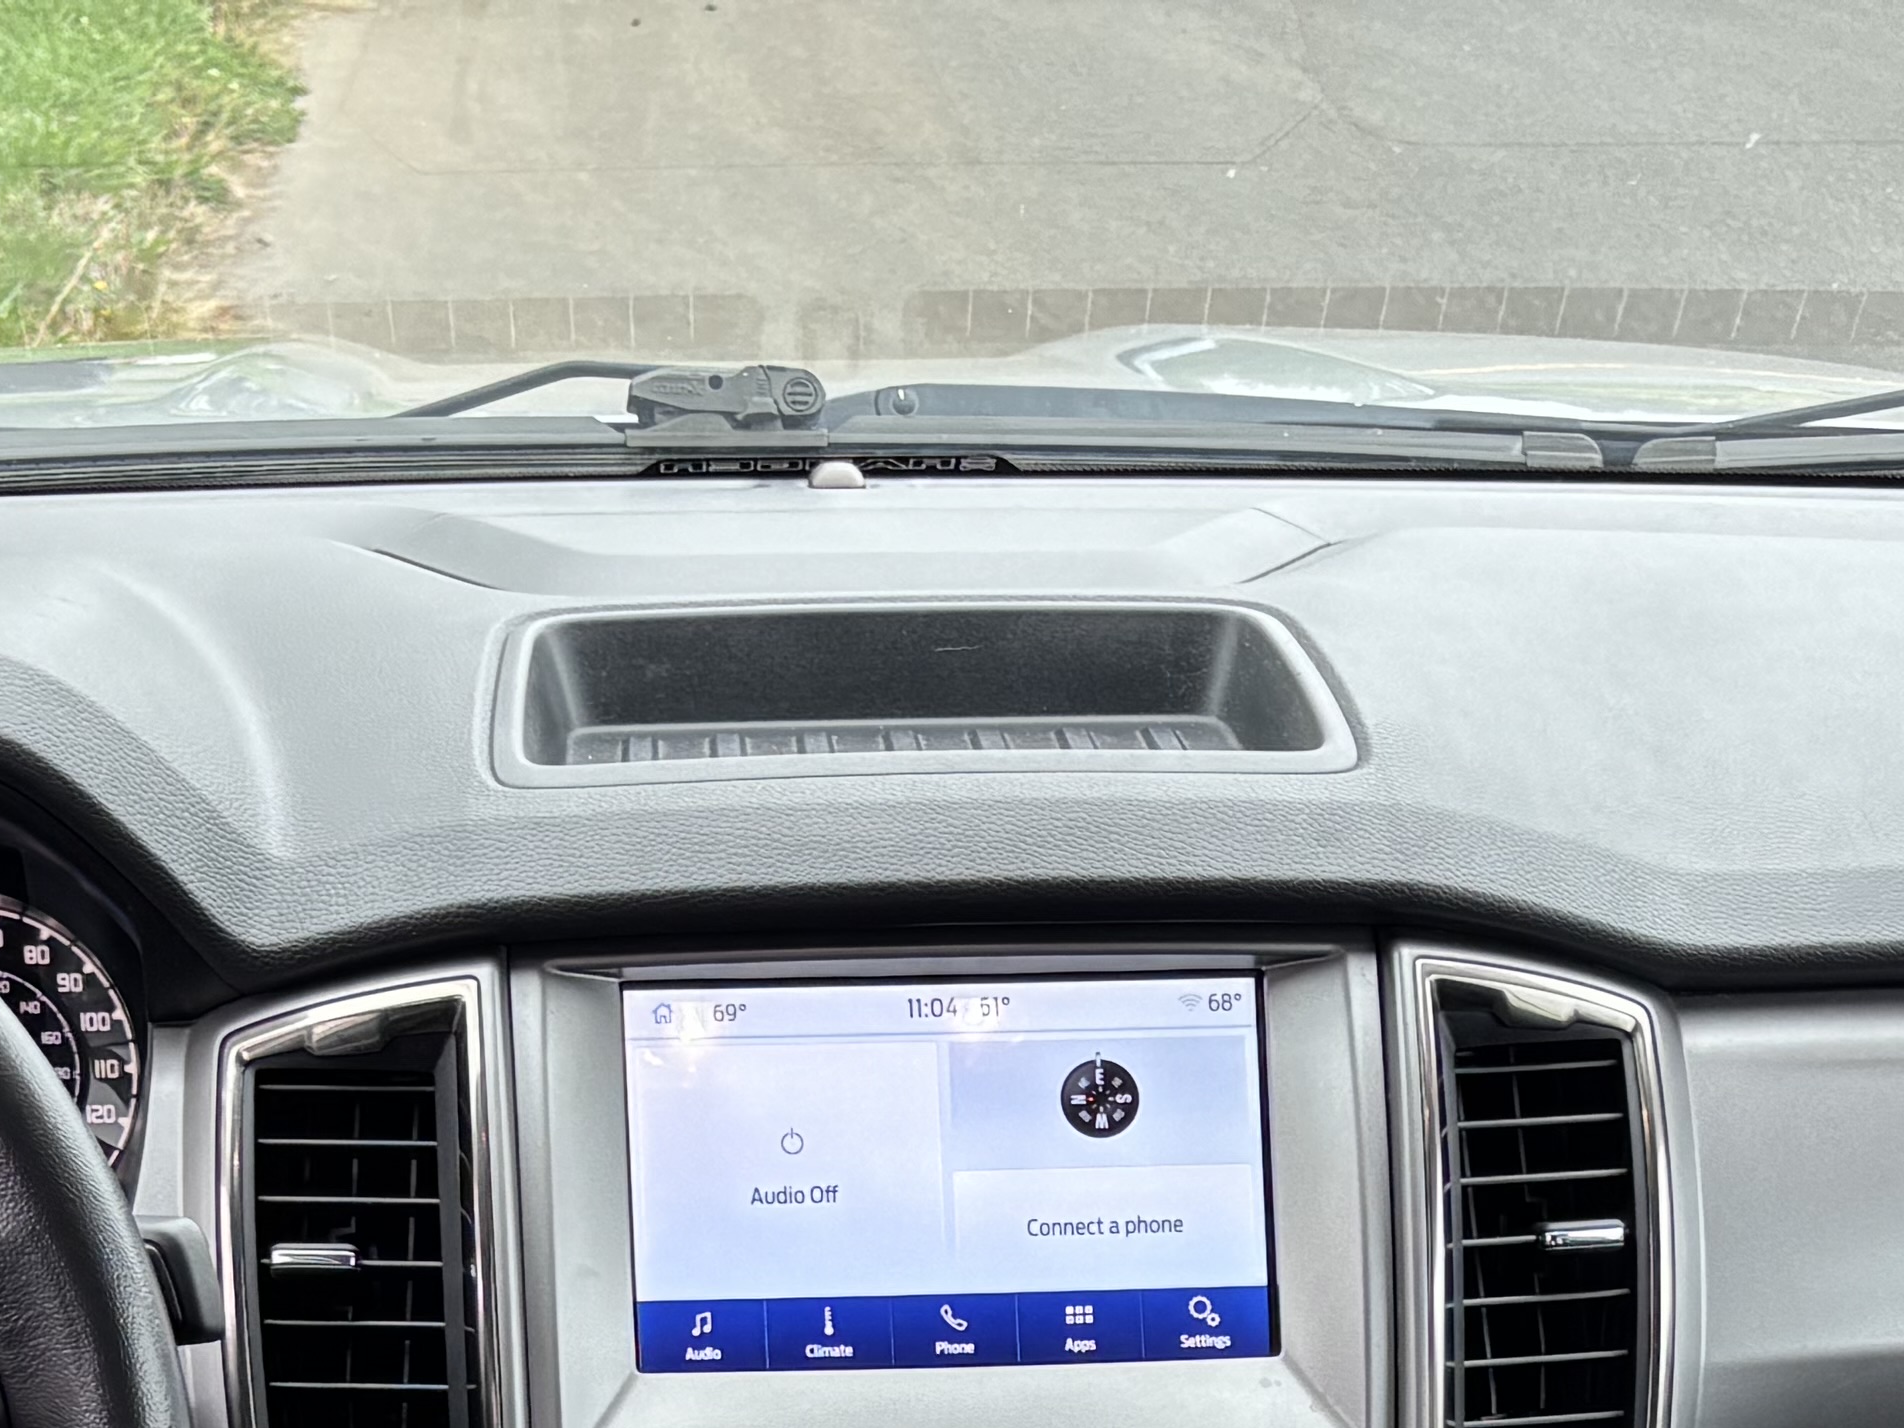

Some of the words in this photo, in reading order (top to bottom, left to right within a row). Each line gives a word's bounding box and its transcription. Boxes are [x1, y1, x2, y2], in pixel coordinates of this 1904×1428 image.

[23, 945, 50, 965] 80
[56, 973, 83, 993] 90
[20, 1001, 41, 1014] 140
[907, 997, 958, 1019] 11:04
[1208, 993, 1242, 1012] 68°
[80, 1012, 111, 1032] 100
[712, 1003, 747, 1022] 69°
[41, 1031, 61, 1045] 160
[95, 1059, 120, 1079] 110
[86, 1104, 116, 1124] 120
[751, 1186, 805, 1205] Audio
[810, 1185, 839, 1204] Off
[1026, 1216, 1104, 1237] Connect
[1109, 1220, 1120, 1234] a
[1125, 1215, 1184, 1237] phone
[805, 1344, 853, 1358] Climate
[935, 1341, 974, 1355] Phone
[1065, 1338, 1096, 1353] Apps
[1180, 1334, 1231, 1350] Settings
[685, 1347, 722, 1361] Audio
